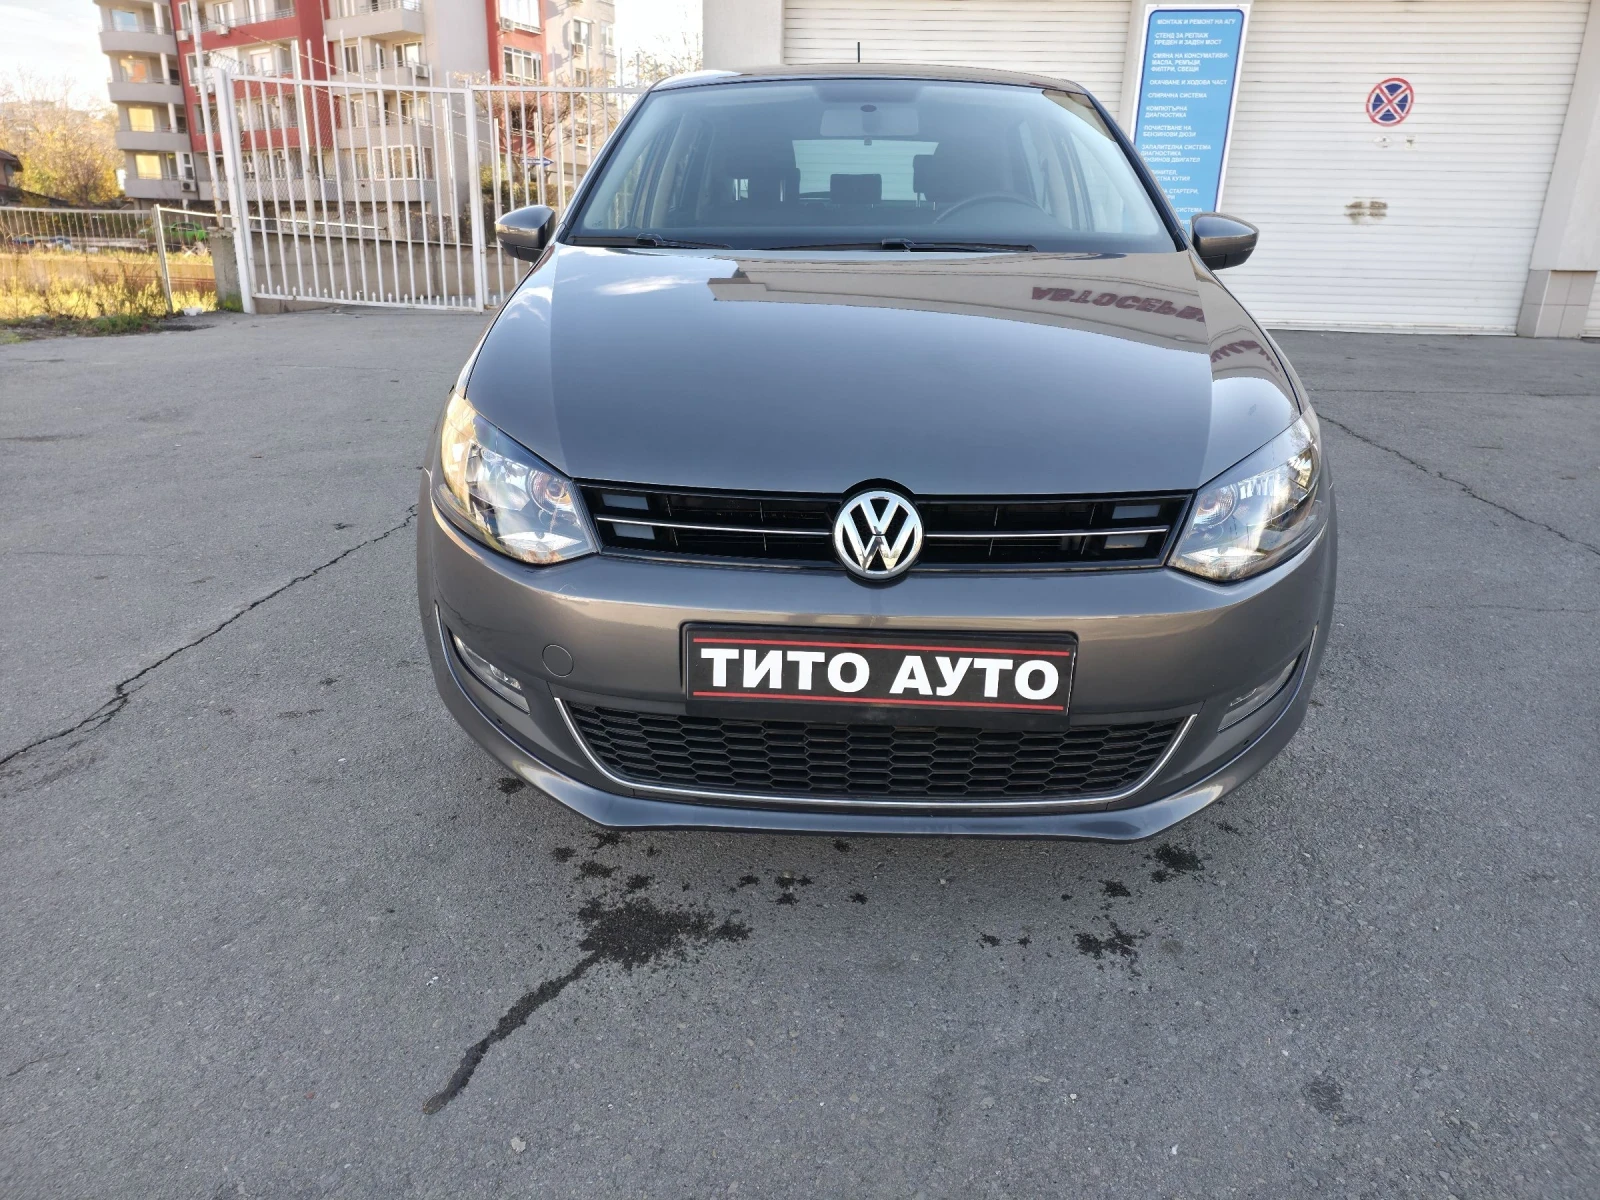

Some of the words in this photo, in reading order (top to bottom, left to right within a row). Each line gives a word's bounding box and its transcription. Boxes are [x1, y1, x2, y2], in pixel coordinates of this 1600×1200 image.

[834, 490, 923, 579] VW
[701, 648, 870, 693] ТИТО
[889, 655, 1059, 700] АУТО
